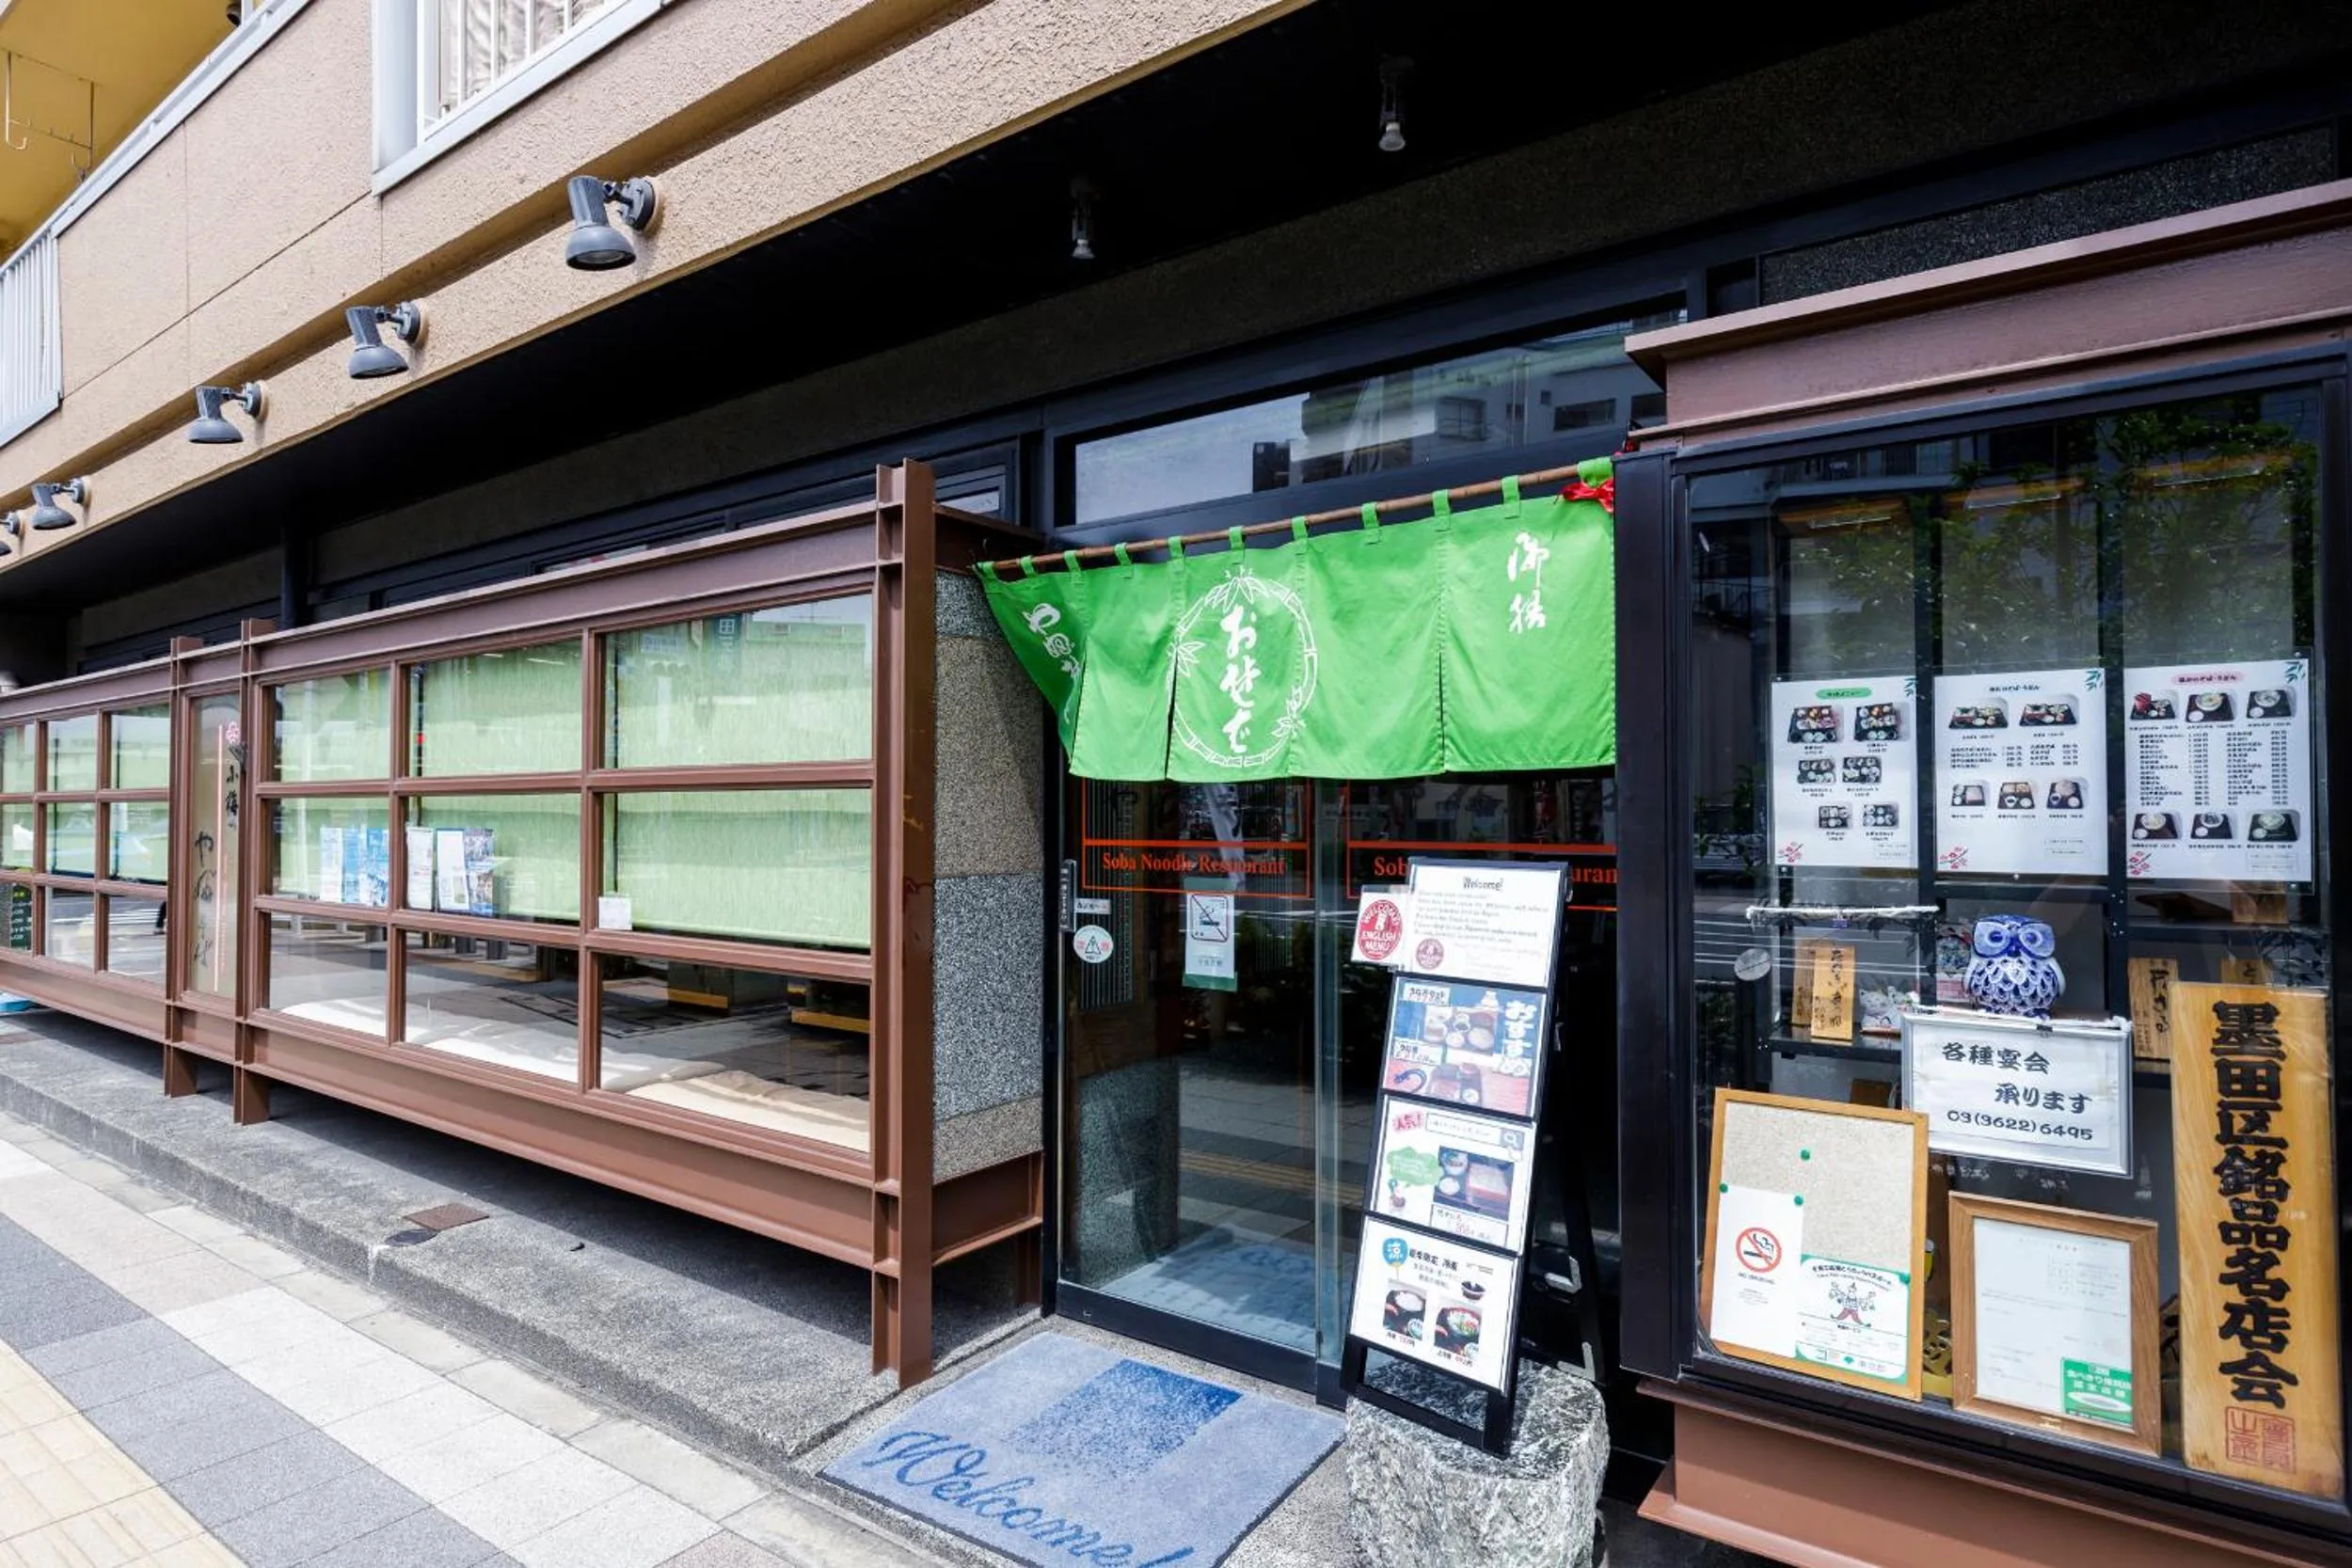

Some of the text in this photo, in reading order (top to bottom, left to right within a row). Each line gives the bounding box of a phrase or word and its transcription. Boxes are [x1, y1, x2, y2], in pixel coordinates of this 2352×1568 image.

[1102, 851, 1136, 871] Soba
[1374, 857, 1409, 877] Sob
[1942, 1041, 2051, 1075] 各種宴会
[1994, 1082, 2092, 1115] 承ります
[1947, 1109, 2094, 1142] 03(3622)6495
[2211, 1000, 2298, 1409] 墨田区銘品名店会
